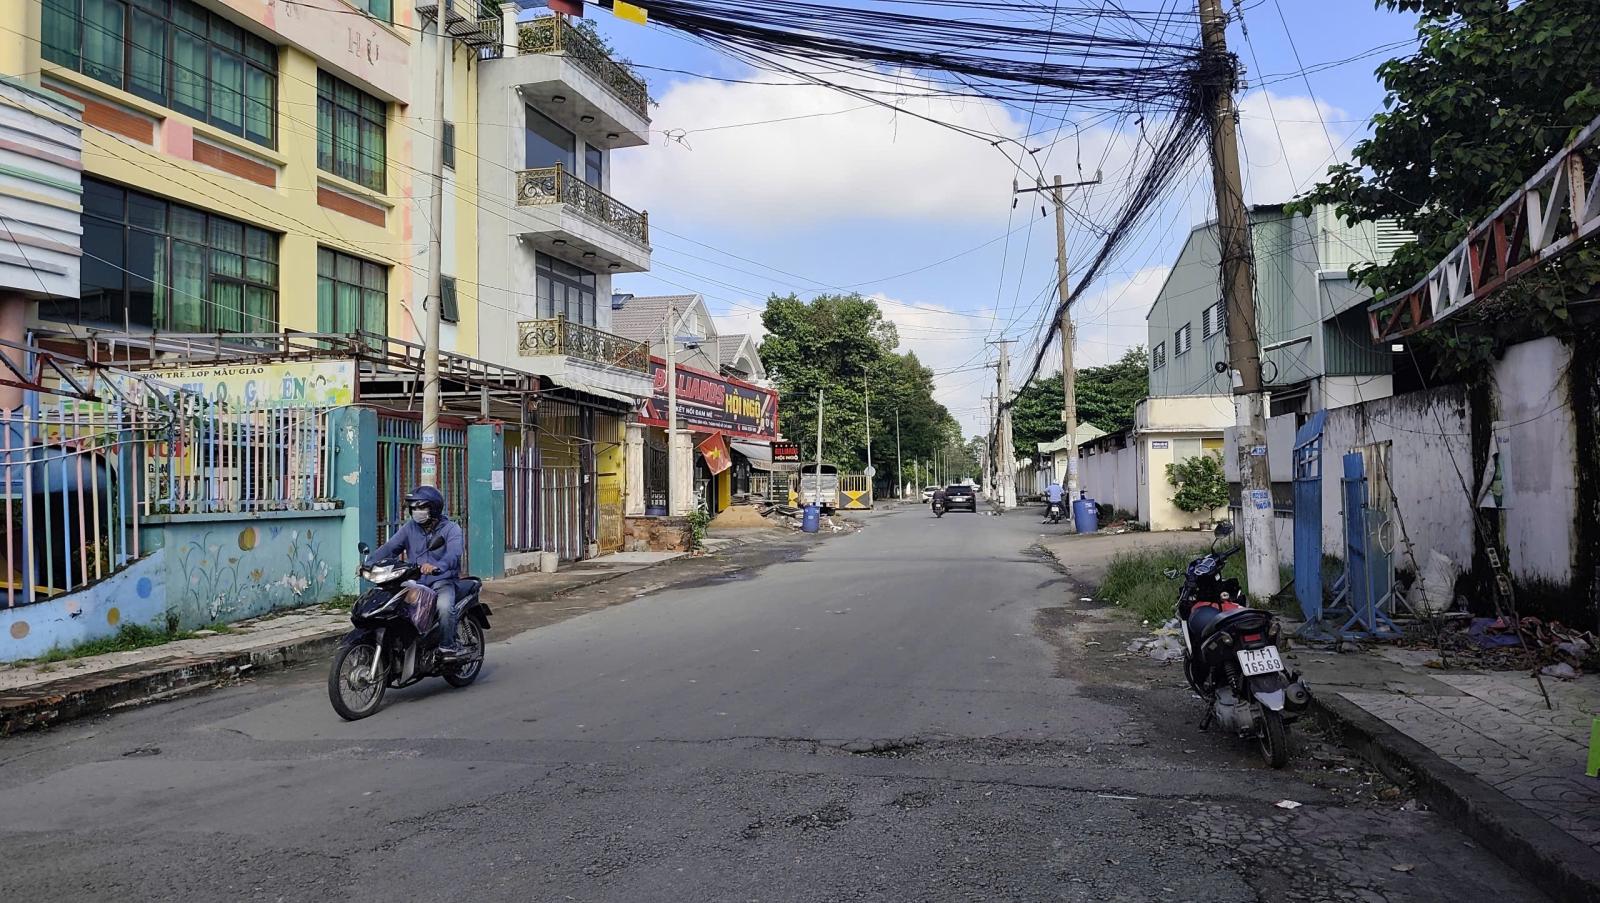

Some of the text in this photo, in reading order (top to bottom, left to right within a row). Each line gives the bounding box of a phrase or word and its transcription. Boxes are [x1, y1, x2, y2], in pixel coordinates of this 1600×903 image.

[654, 368, 726, 405] BLIARDS
[725, 388, 742, 420] HỘI
[742, 394, 761, 424] NGỘ
[1244, 649, 1272, 661] 77-F1
[1245, 659, 1280, 674] 165.69
